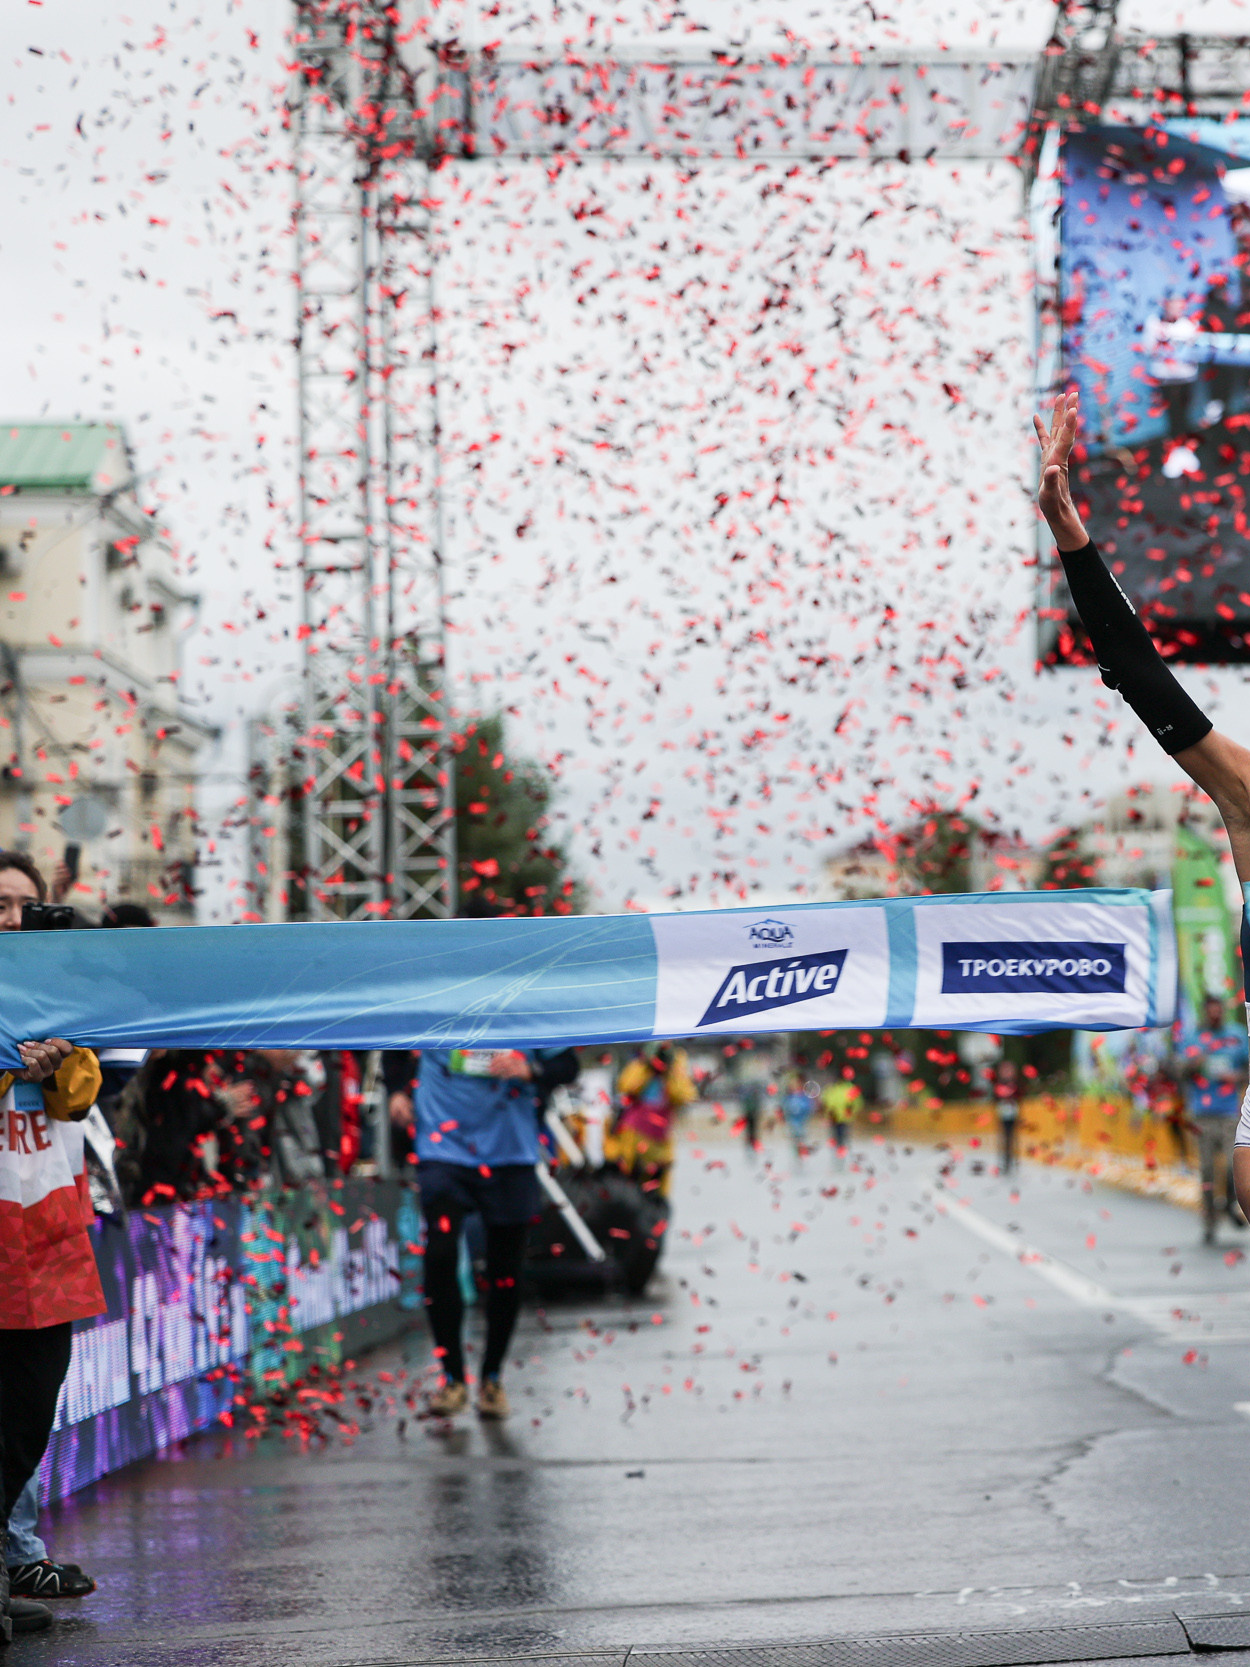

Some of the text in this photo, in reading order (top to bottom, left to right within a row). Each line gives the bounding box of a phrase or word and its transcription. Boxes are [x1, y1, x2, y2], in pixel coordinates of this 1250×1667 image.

[749, 926, 795, 942] AQUA
[957, 958, 1112, 977] ТРОЕКУРОВО
[0, 1110, 52, 1154] RE
